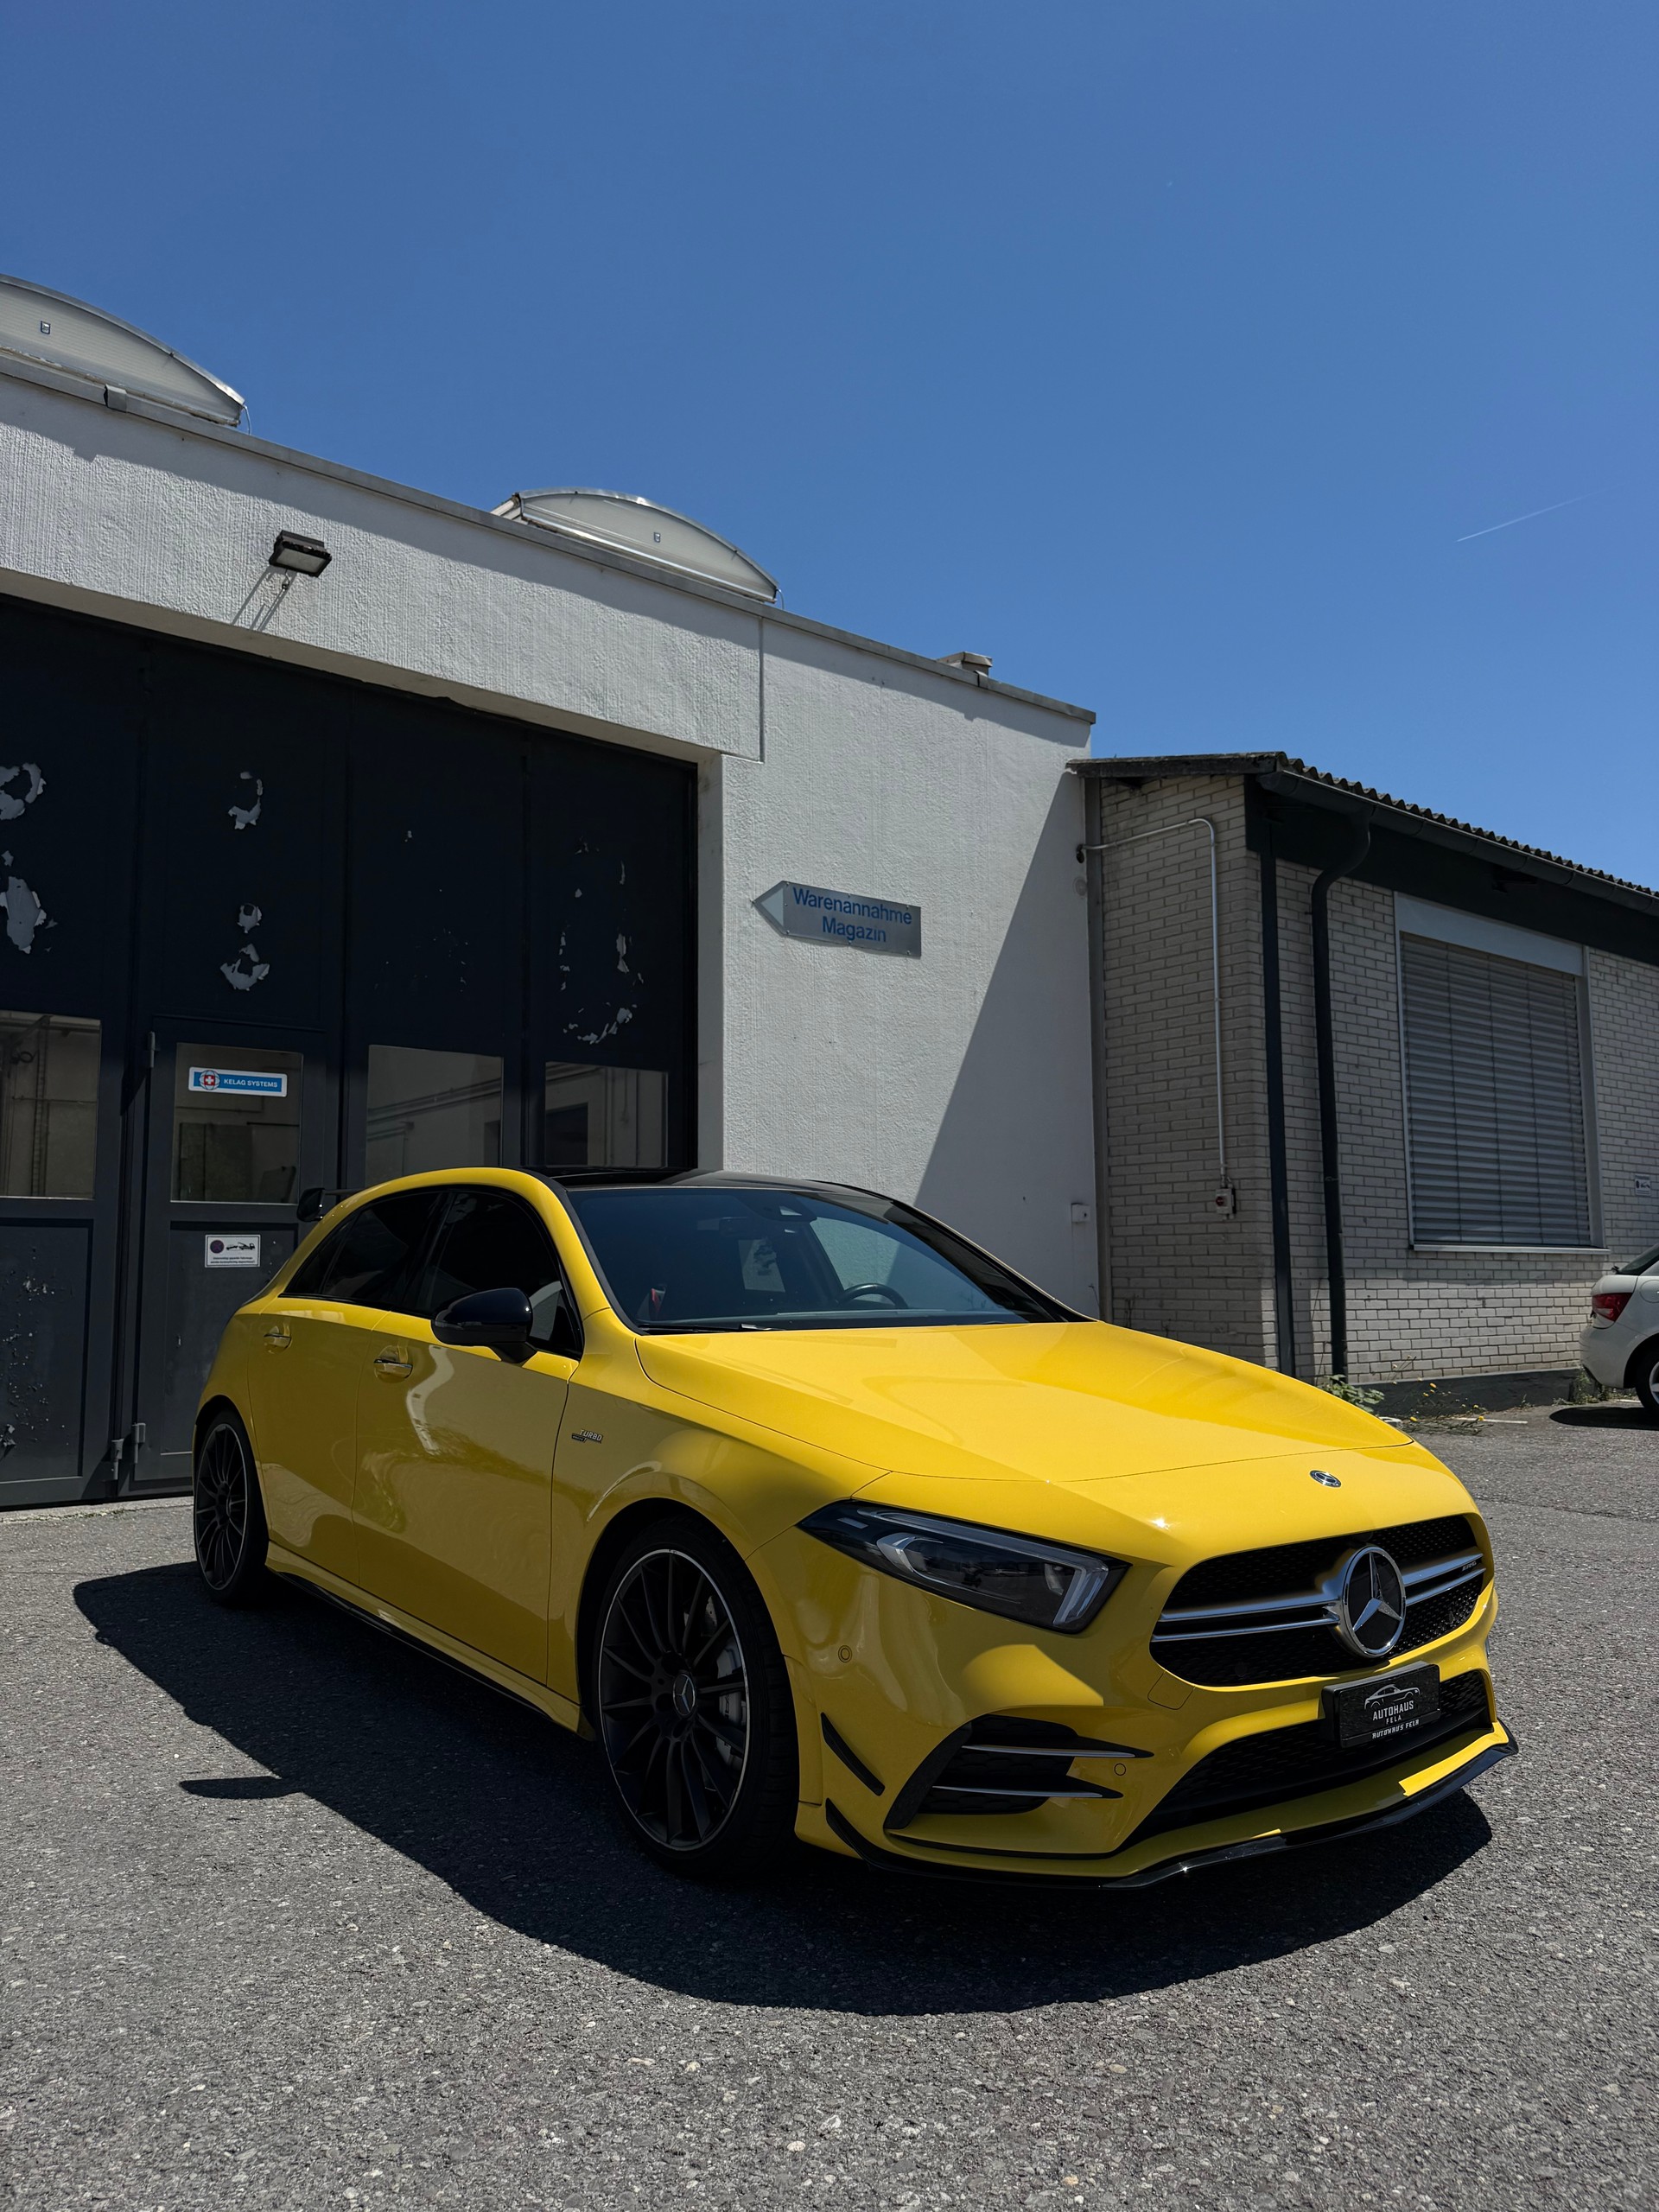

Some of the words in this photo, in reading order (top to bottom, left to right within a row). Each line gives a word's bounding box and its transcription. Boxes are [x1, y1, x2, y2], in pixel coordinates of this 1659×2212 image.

[792, 887, 912, 925] Warenannahme
[823, 916, 887, 941] Magazin
[580, 1429, 602, 1441] TURBO
[1372, 1700, 1414, 1720] AUTOHAUS
[1386, 1714, 1402, 1725] FELA
[1372, 1724, 1404, 1739] AUTOHAUS
